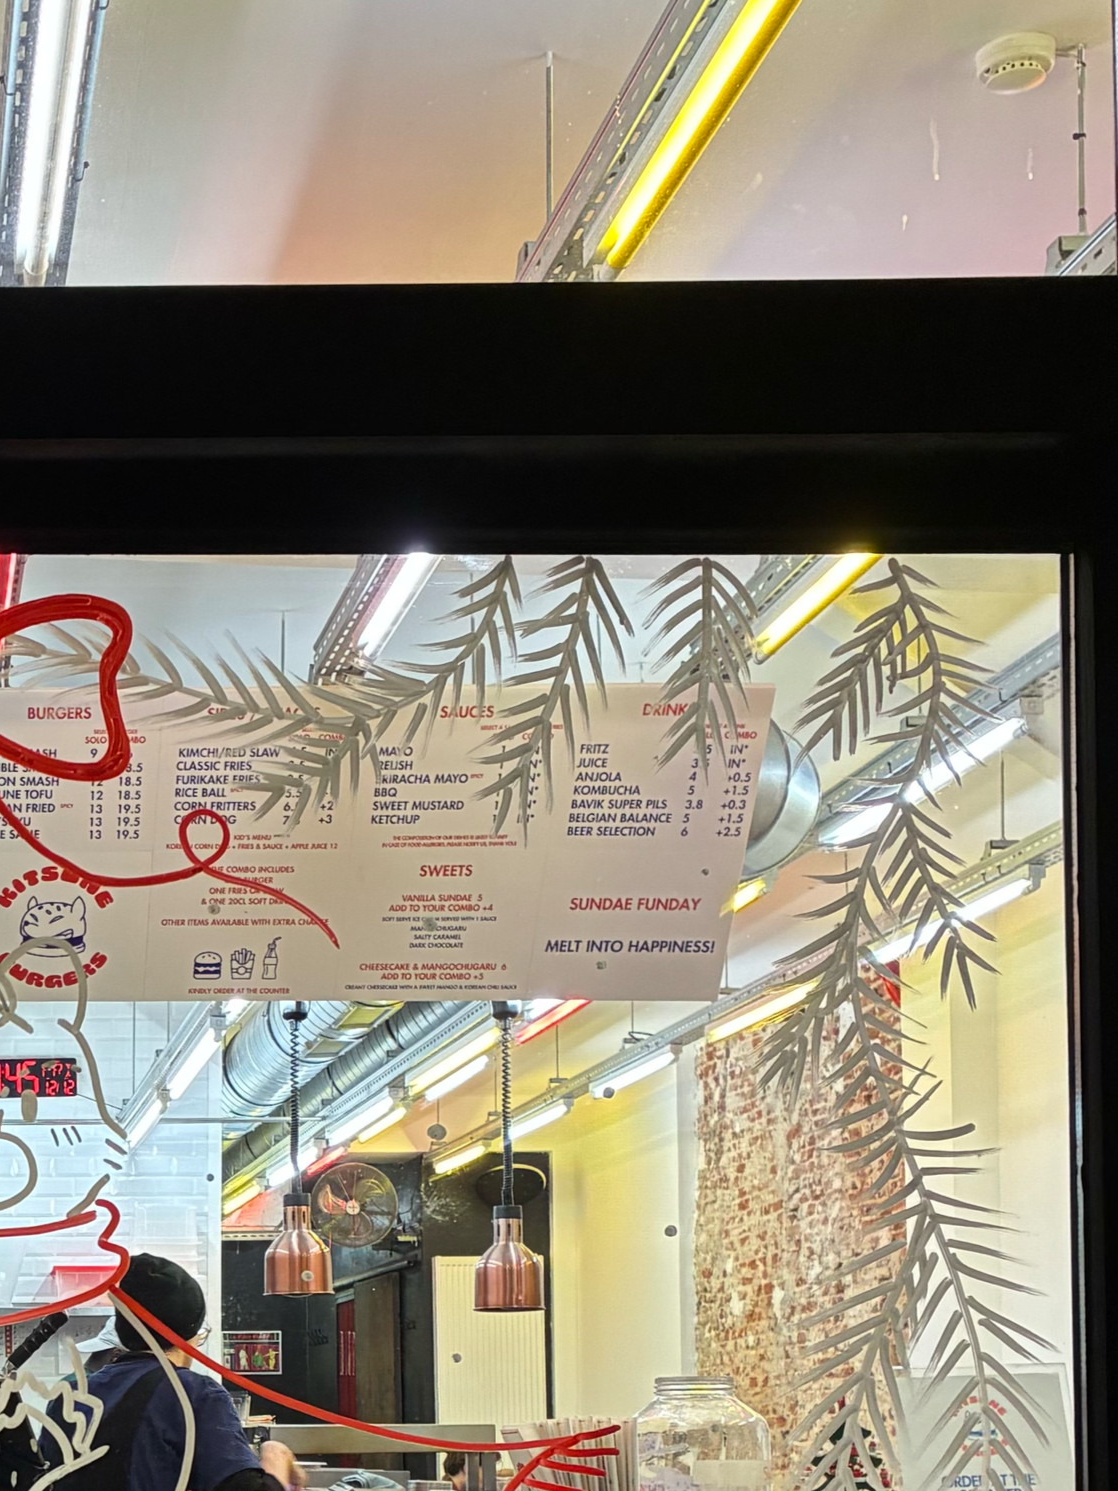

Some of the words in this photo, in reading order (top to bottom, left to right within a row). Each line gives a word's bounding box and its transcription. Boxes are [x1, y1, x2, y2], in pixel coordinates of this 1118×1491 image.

[27, 707, 91, 720] BURGERS
[440, 705, 494, 718] SAUCES
[91, 749, 97, 758] 9
[179, 748, 246, 758] KIMCHI/RED
[250, 748, 280, 758] SLAW
[379, 746, 413, 756] MAYO
[580, 744, 610, 754] FRITZ
[176, 761, 222, 771] CLASSIC
[224, 761, 252, 771] FRIES
[577, 758, 608, 768] JUICE
[20, 777, 59, 786] SMASH
[119, 777, 142, 786] 18.5
[176, 775, 229, 784] FURIKAKE
[434, 774, 468, 784] MAYO
[575, 772, 622, 782] ANJOLA
[689, 772, 696, 781] 4
[25, 790, 53, 799] TOFU
[91, 791, 103, 800] 12
[118, 791, 141, 800] 18.5
[175, 788, 198, 798] RICE
[202, 788, 226, 798] BALL
[374, 788, 397, 798] BBQ
[573, 785, 641, 795] KOMBUCHA
[687, 786, 695, 795] 5
[723, 786, 749, 795] +1.5
[26, 804, 55, 813] FRIED
[90, 804, 103, 814] 13
[118, 804, 141, 813] 19.5
[211, 802, 256, 811] FRITTERS
[372, 801, 409, 811] SWEET
[412, 801, 464, 810] MUSTARD
[571, 799, 606, 809] BAVIK
[608, 799, 642, 809] SUPER
[645, 799, 667, 809] PILS
[685, 800, 703, 809] 3.8
[721, 800, 746, 809] +0.3
[90, 818, 102, 827] 13
[117, 817, 140, 827] 19.5
[371, 815, 420, 825] KETCHUP
[568, 813, 616, 823] BELGIAN
[620, 813, 672, 823] BALANCE
[682, 814, 689, 823] 5
[718, 814, 744, 823] +1.5
[90, 830, 101, 839] 13
[116, 830, 140, 839] 19.5
[567, 827, 593, 836] BEER
[596, 827, 656, 836] SELECTION
[681, 827, 688, 836] 6
[716, 827, 741, 836] +2.5
[419, 864, 473, 877] SWEETS
[438, 894, 472, 902] SUNDAE
[389, 904, 407, 912] ADD
[409, 904, 420, 912] TO
[422, 904, 446, 912] YOUR
[448, 904, 480, 912] COMBO
[569, 898, 633, 911] SUNDAE
[637, 898, 702, 911] FUNDAY
[544, 940, 582, 953] MELT
[586, 940, 623, 952] INTO
[628, 940, 715, 954] HAPPINESS!
[360, 963, 410, 971] CHEESECAKE
